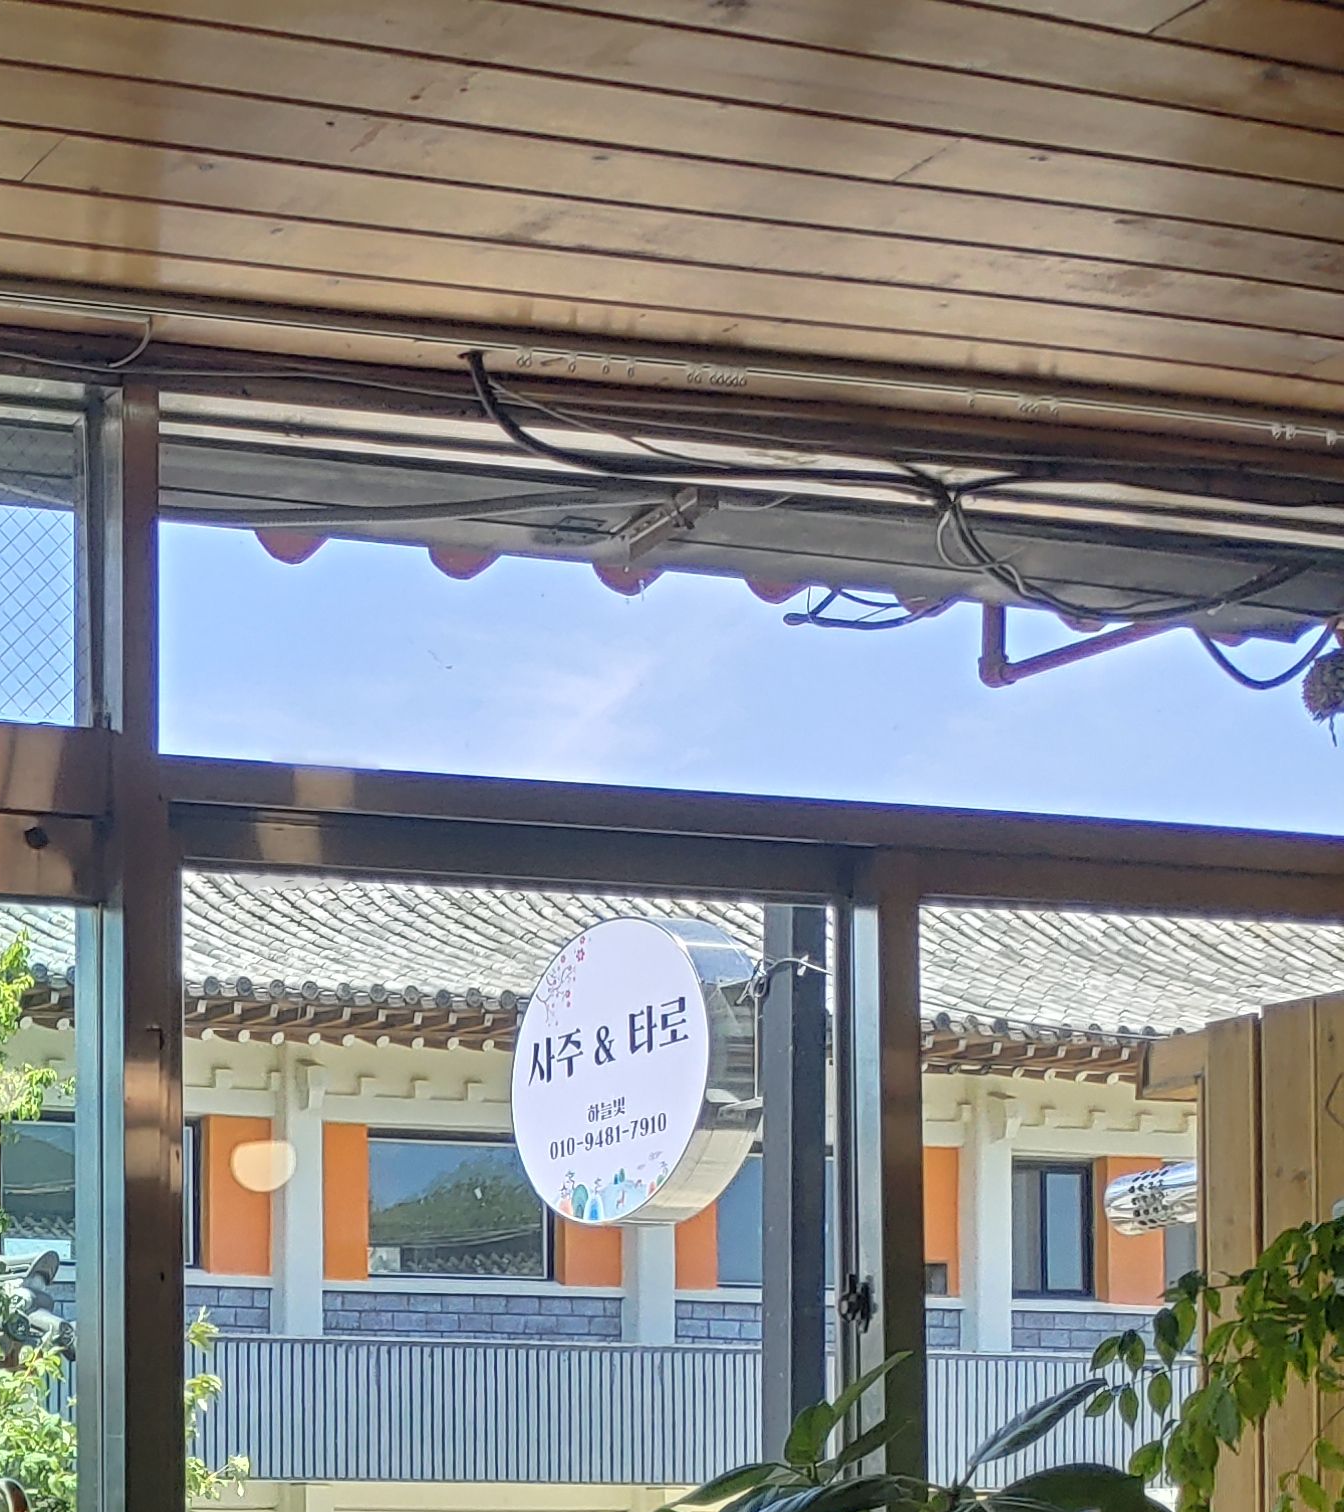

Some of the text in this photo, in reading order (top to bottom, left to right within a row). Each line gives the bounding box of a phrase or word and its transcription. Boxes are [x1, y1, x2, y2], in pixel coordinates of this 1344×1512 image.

[528, 996, 689, 1087] 사주 & 타로
[550, 1112, 667, 1160] 010-9481-7910
